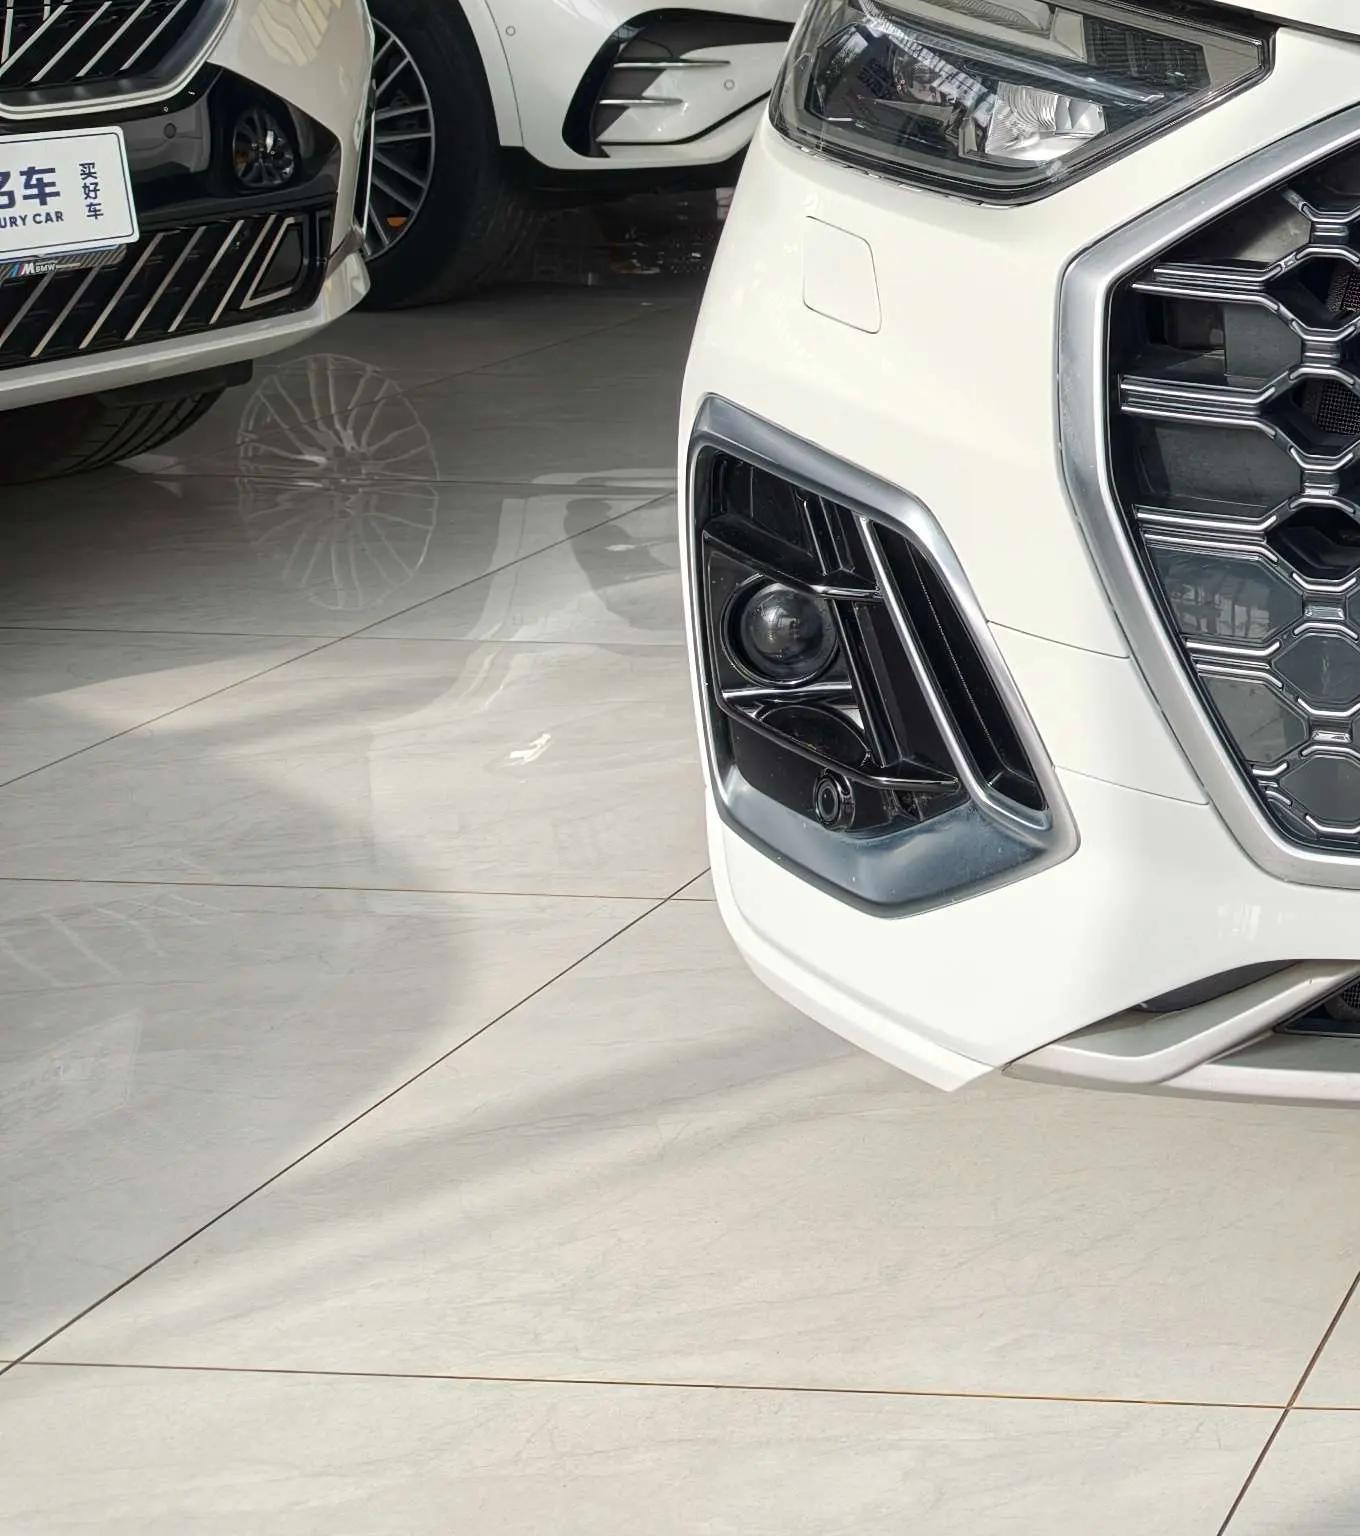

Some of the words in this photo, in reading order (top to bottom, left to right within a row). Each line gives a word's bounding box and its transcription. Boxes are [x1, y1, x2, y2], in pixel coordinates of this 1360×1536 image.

[79, 162, 104, 220] 买好车
[32, 210, 64, 225] CAR
